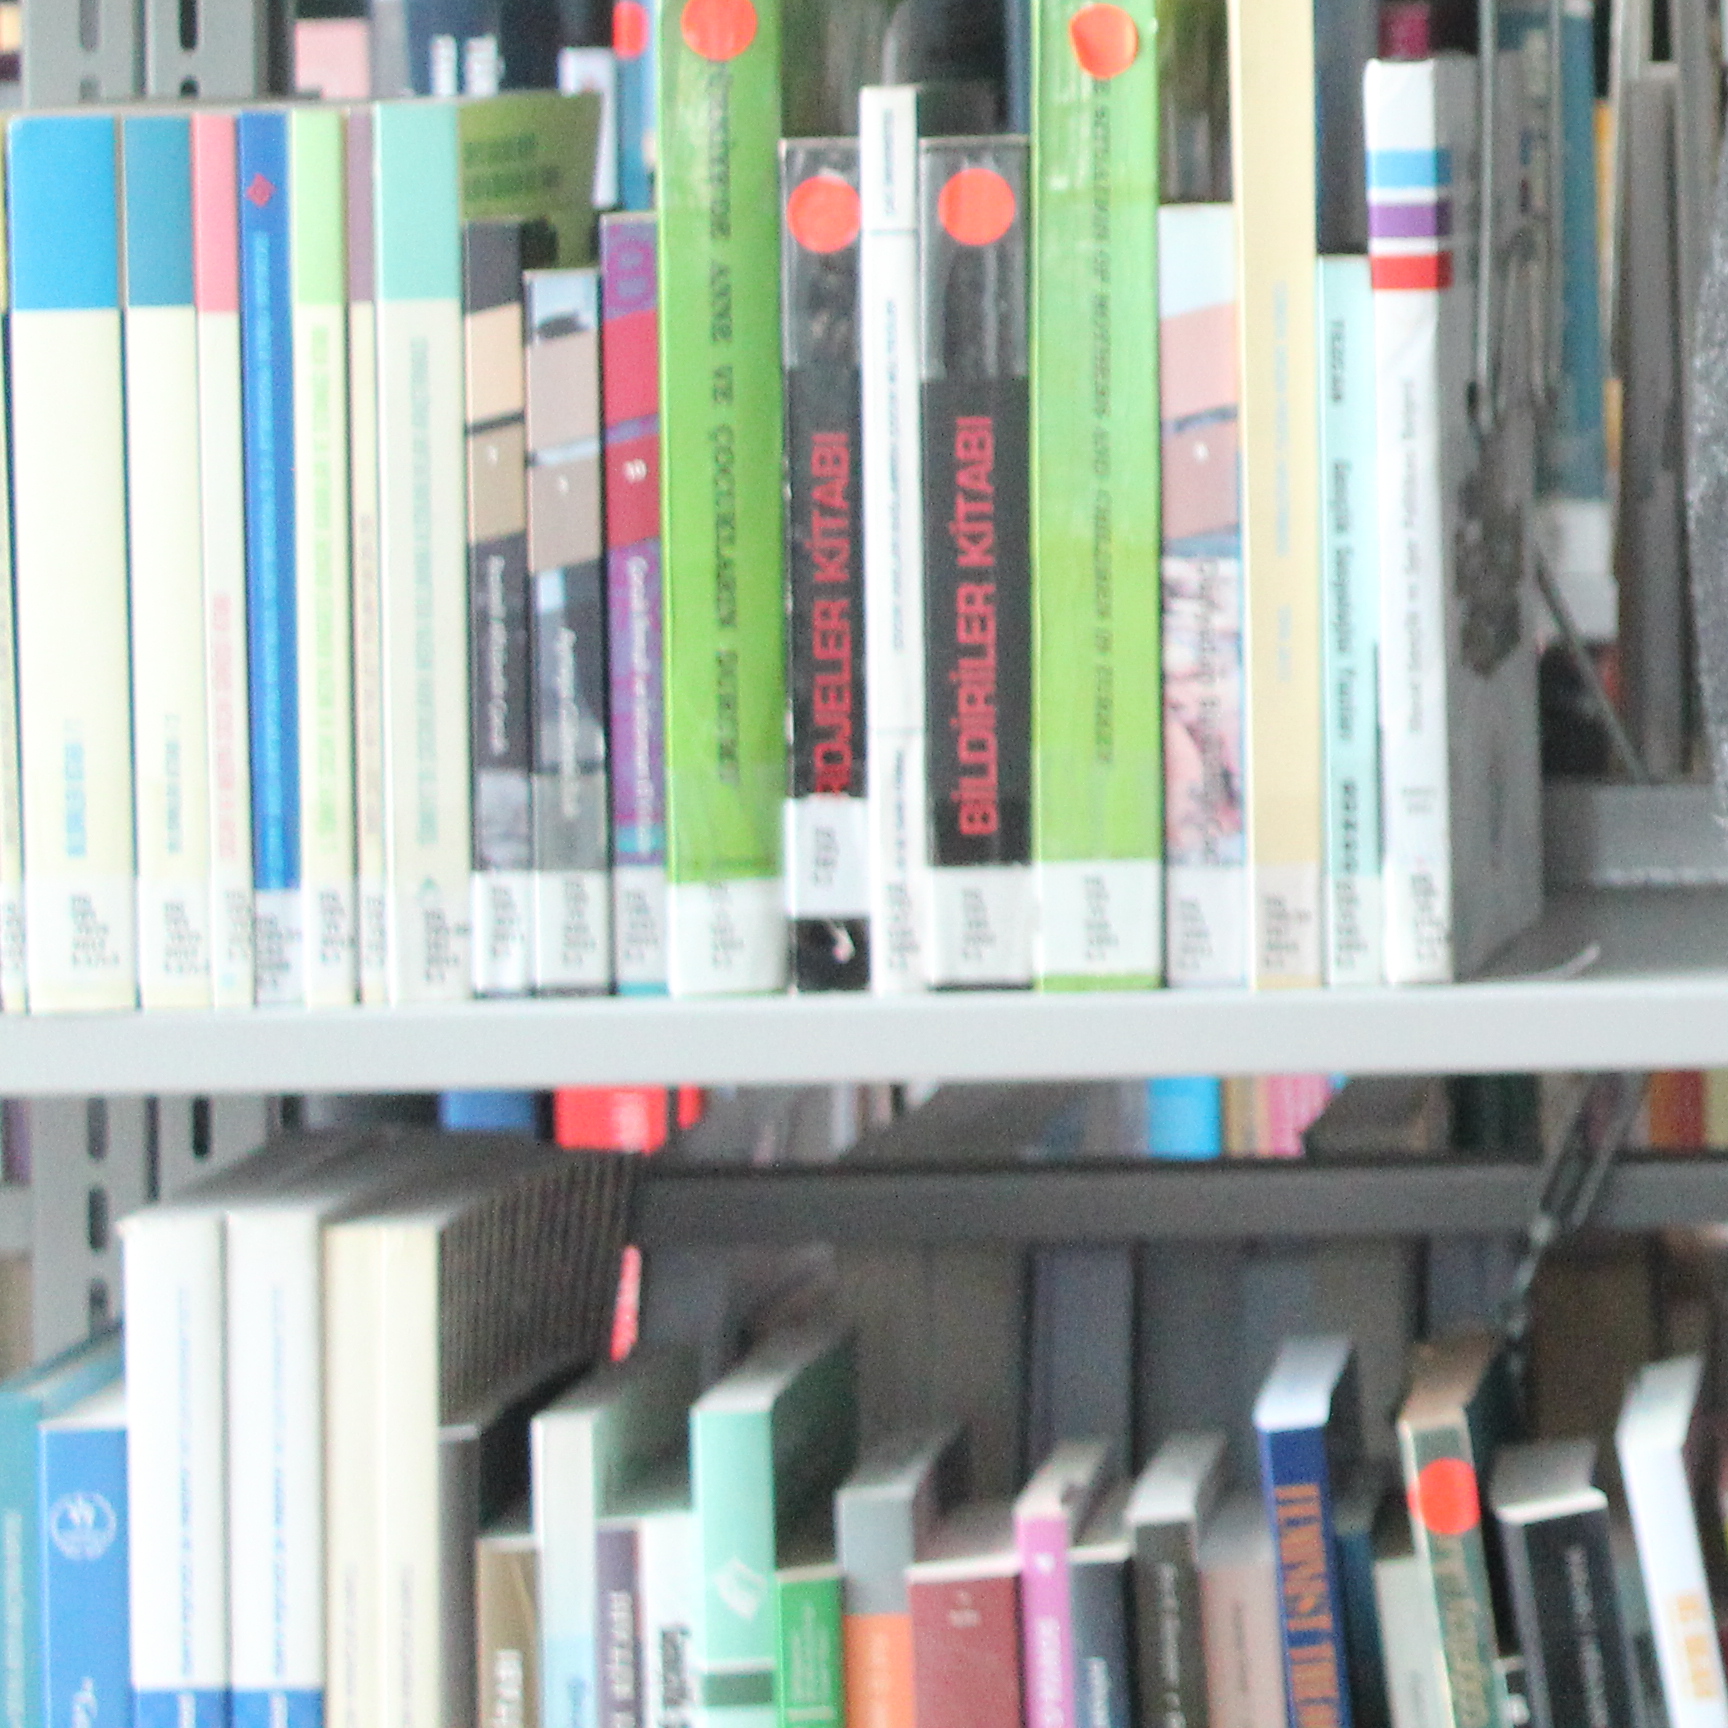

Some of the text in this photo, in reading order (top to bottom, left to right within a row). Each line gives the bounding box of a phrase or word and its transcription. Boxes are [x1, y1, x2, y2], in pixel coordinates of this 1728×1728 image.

[807, 431, 851, 583] KİTABI
[948, 415, 999, 836] BİLDİRİLER KİTABI
